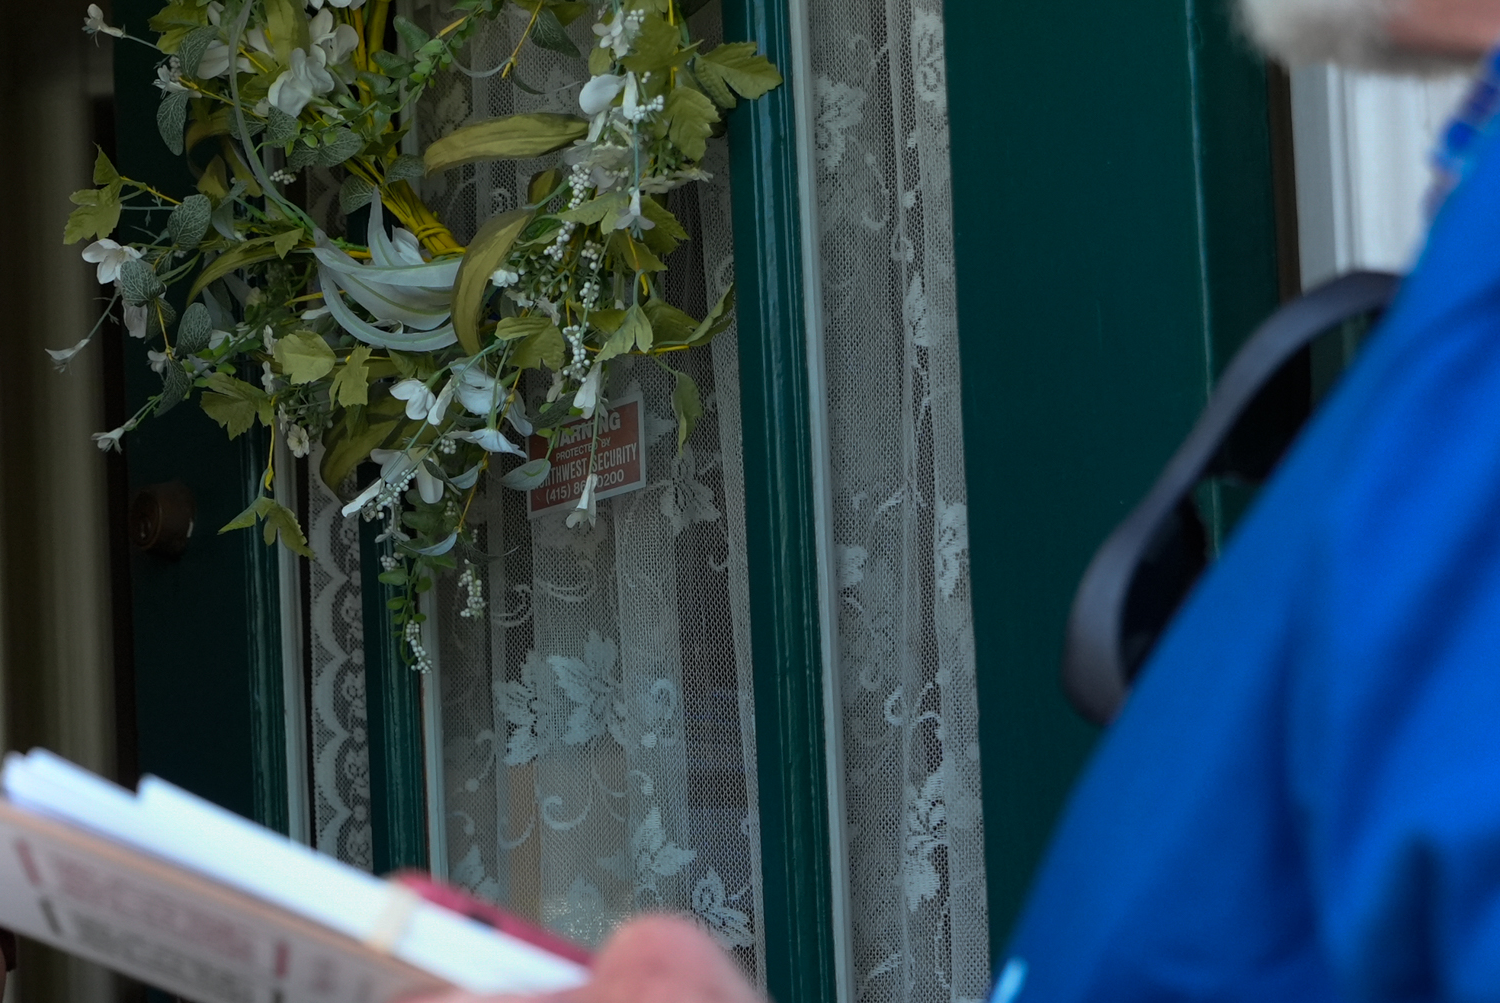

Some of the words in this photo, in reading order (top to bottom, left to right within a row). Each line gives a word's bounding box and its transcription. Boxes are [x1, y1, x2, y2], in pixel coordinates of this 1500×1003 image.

[601, 437, 611, 448] BY
[592, 442, 637, 473] SECURITY
[546, 483, 571, 504] (415)
